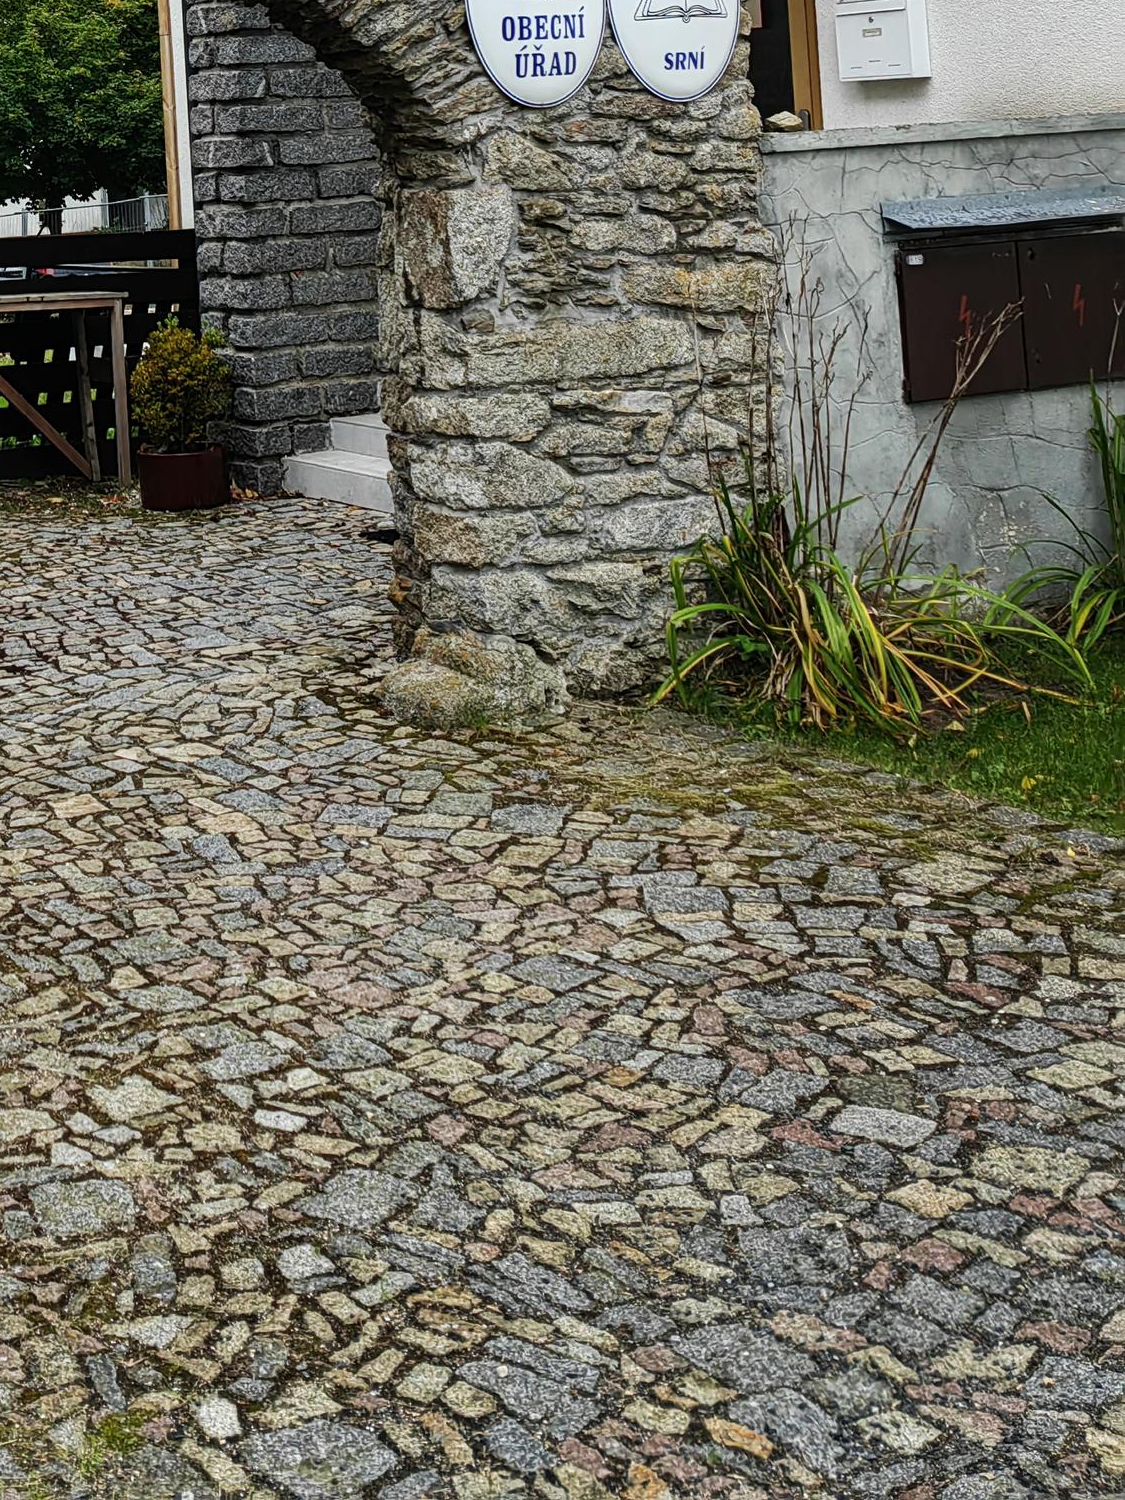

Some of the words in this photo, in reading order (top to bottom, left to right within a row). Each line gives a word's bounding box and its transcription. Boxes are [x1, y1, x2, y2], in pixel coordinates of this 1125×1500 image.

[501, 6, 585, 41] OBECNÍ
[515, 44, 576, 78] ÚŘAD
[664, 46, 705, 70] SRNÍ
